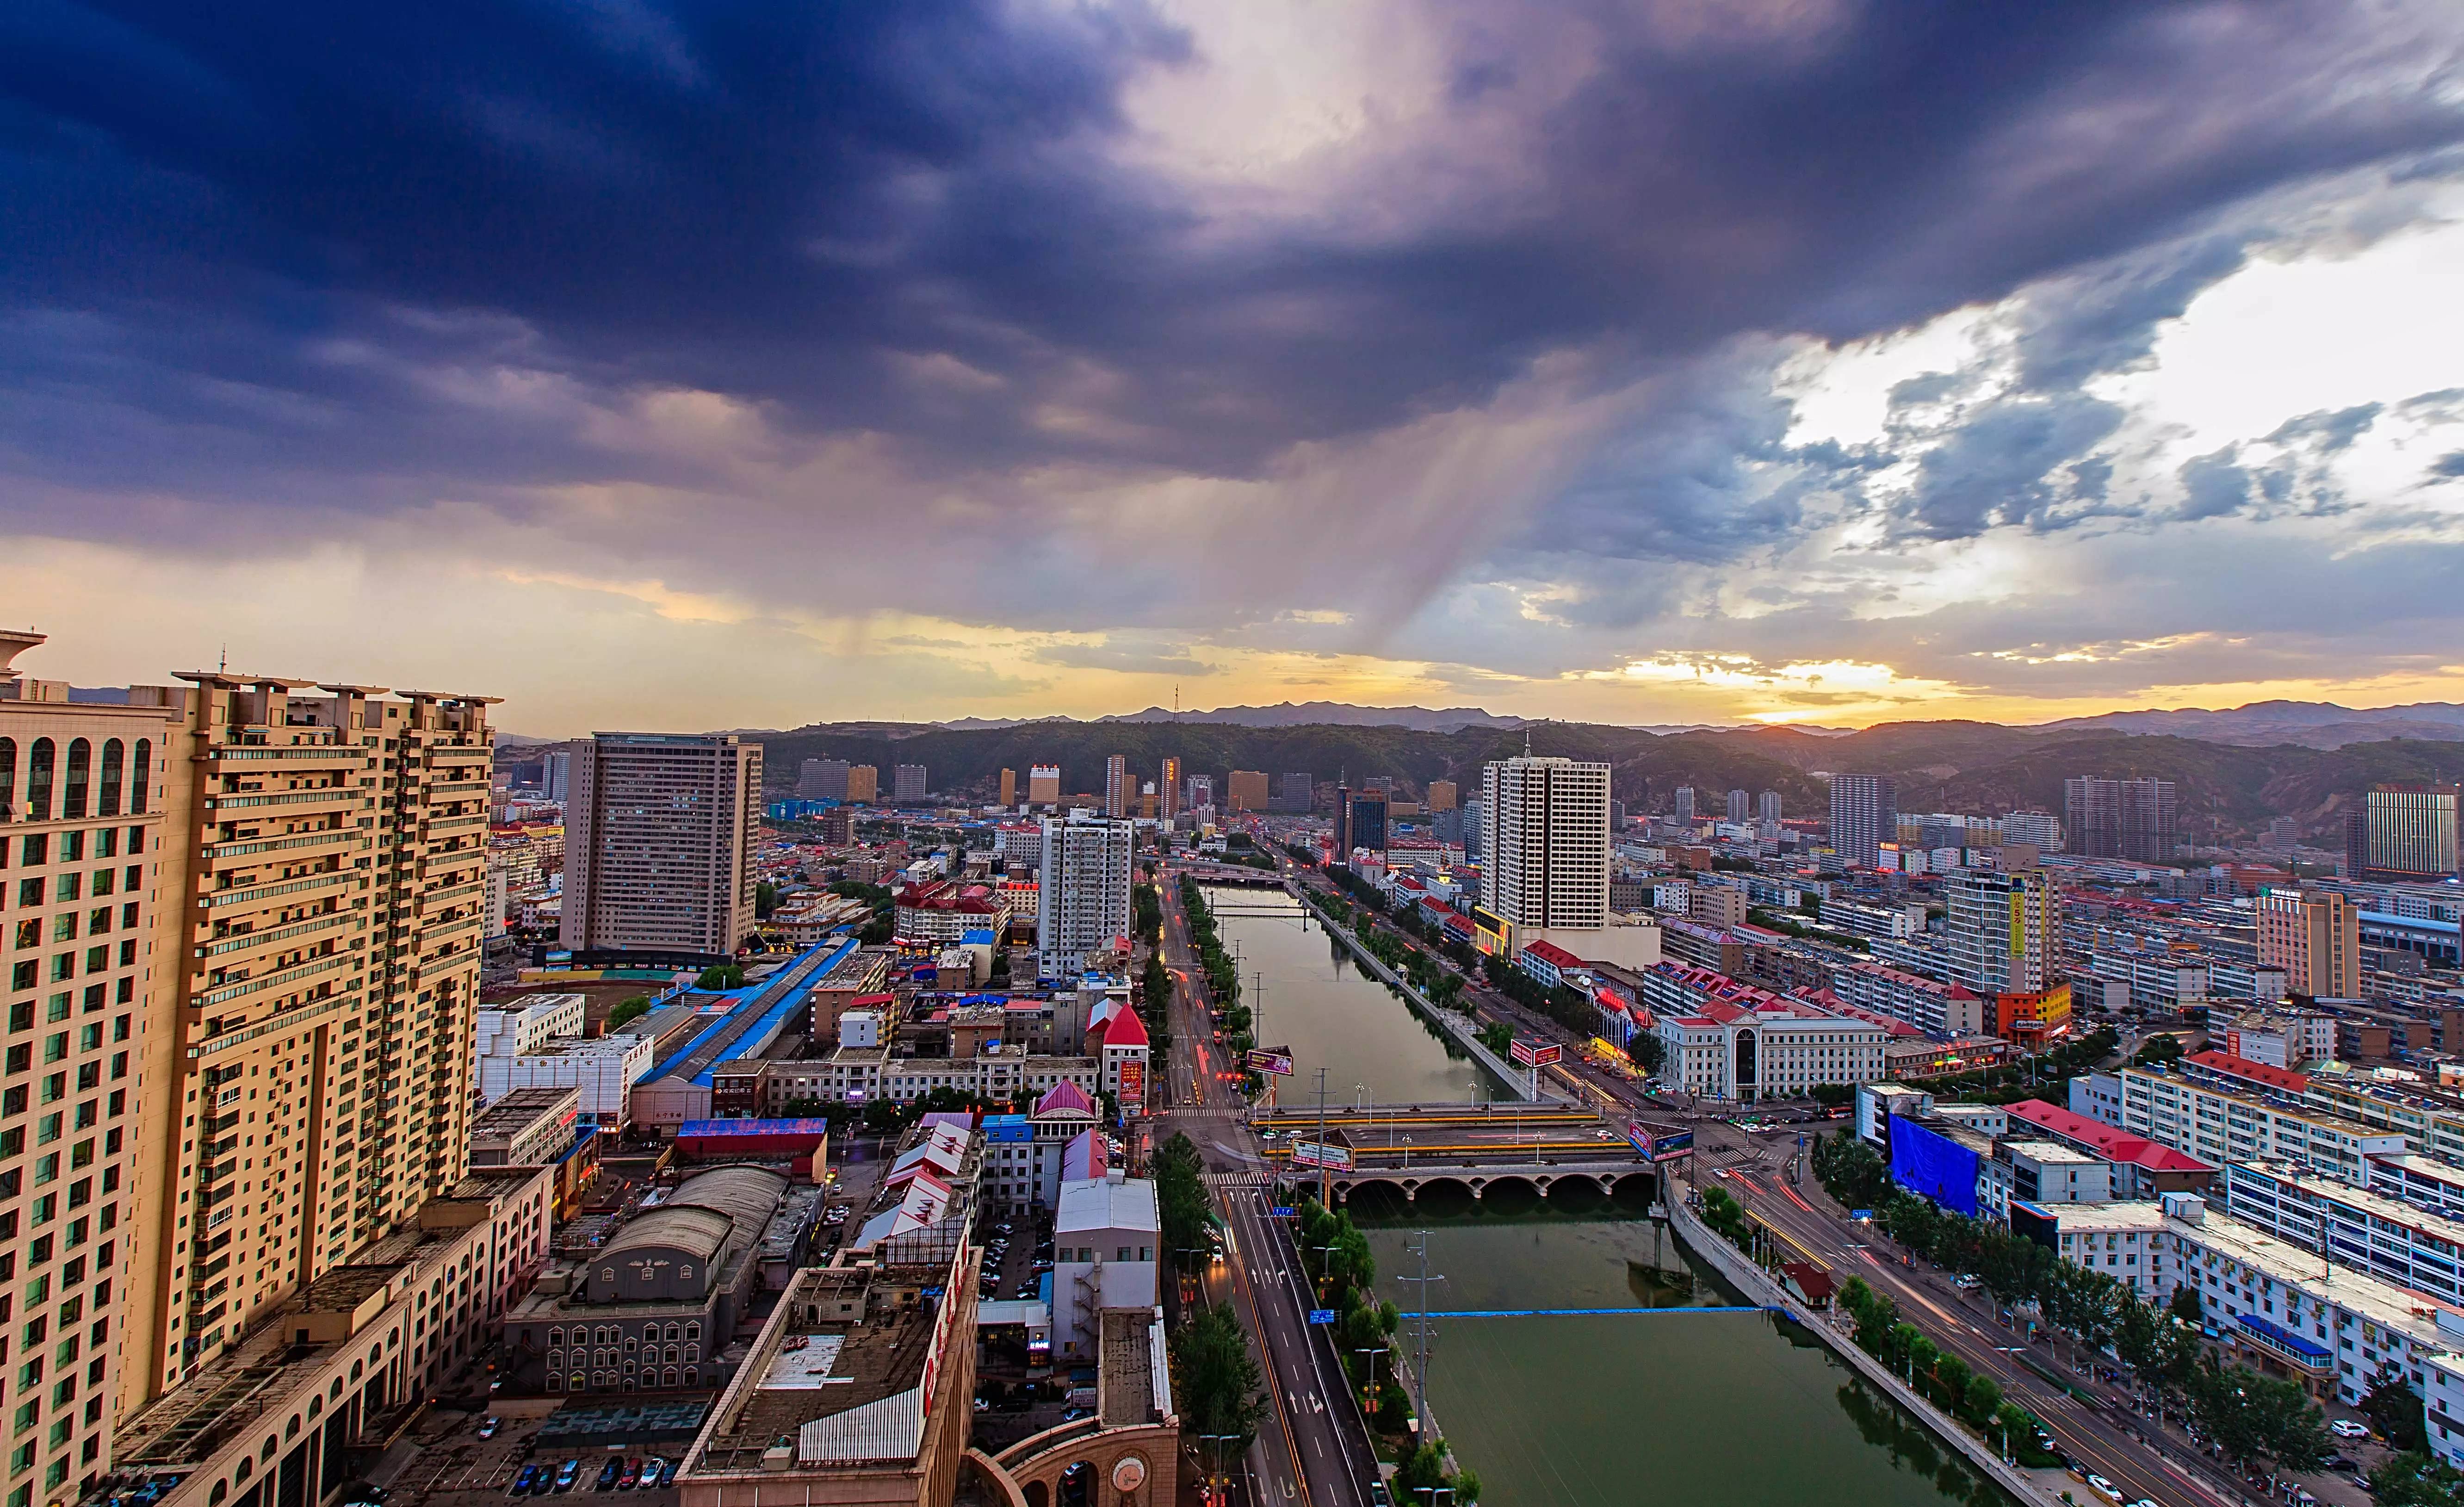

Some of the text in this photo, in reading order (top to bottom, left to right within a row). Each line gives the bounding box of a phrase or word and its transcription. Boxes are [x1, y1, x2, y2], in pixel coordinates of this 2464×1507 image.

[2270, 888, 2301, 898] 中国农业银行
[517, 1059, 593, 1067] 购物中心
